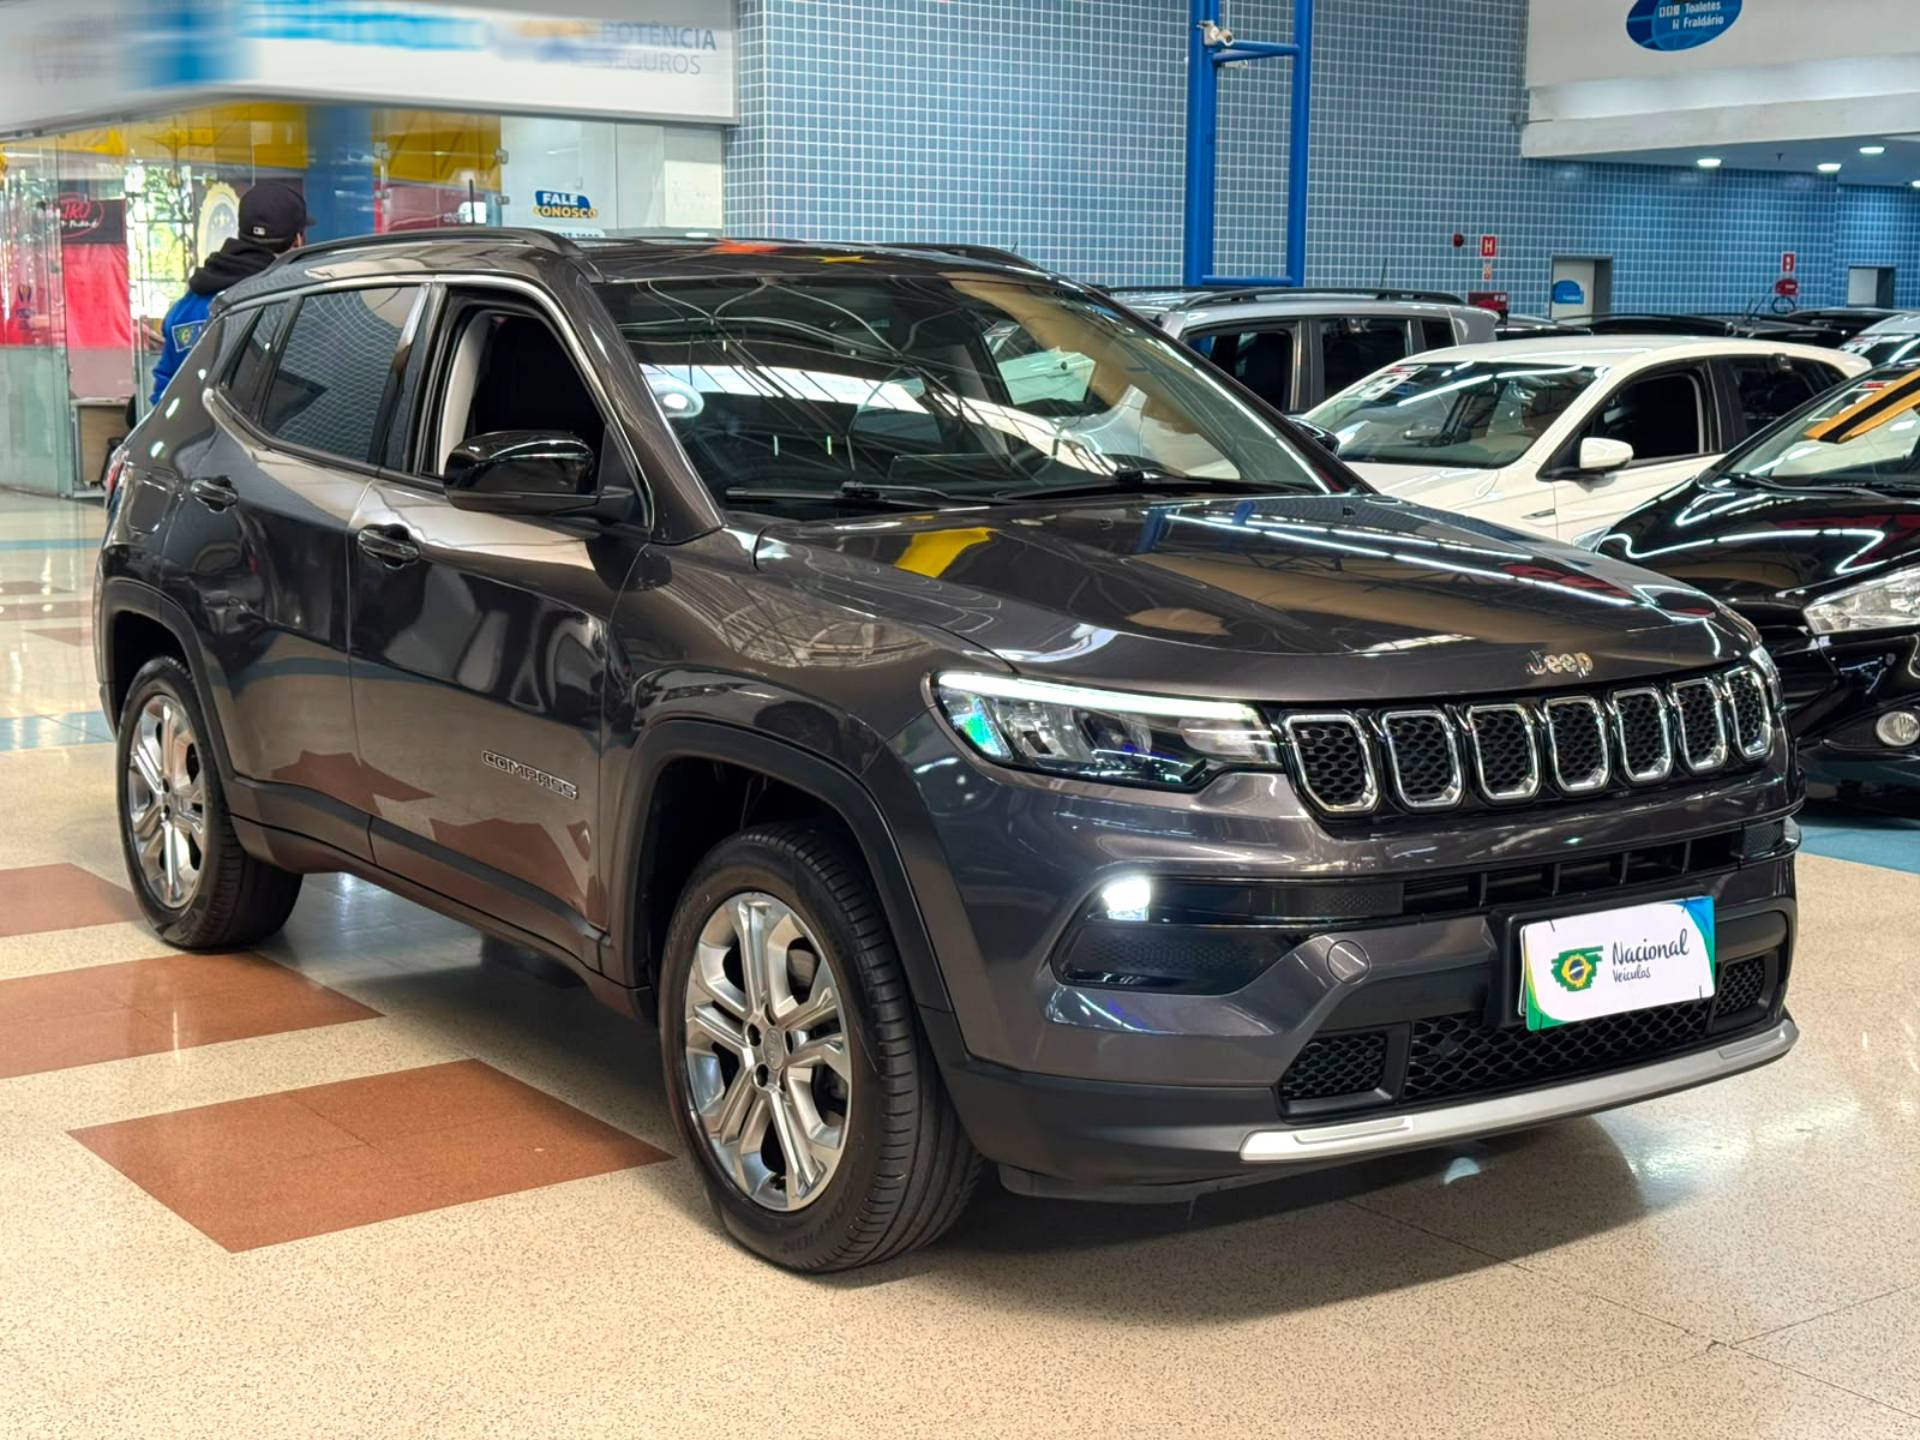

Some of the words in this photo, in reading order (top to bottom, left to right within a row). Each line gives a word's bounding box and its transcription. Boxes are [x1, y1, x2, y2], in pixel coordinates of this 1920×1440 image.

[1685, 1, 1721, 14] Toaletes
[1683, 14, 1724, 28] Fraldário
[542, 192, 578, 206] FALE
[531, 205, 598, 219] CONOSCO
[1484, 239, 1493, 254] H
[1525, 650, 1593, 678] Jeep
[481, 750, 577, 800] COMPASS
[1612, 928, 1690, 966] Nacional
